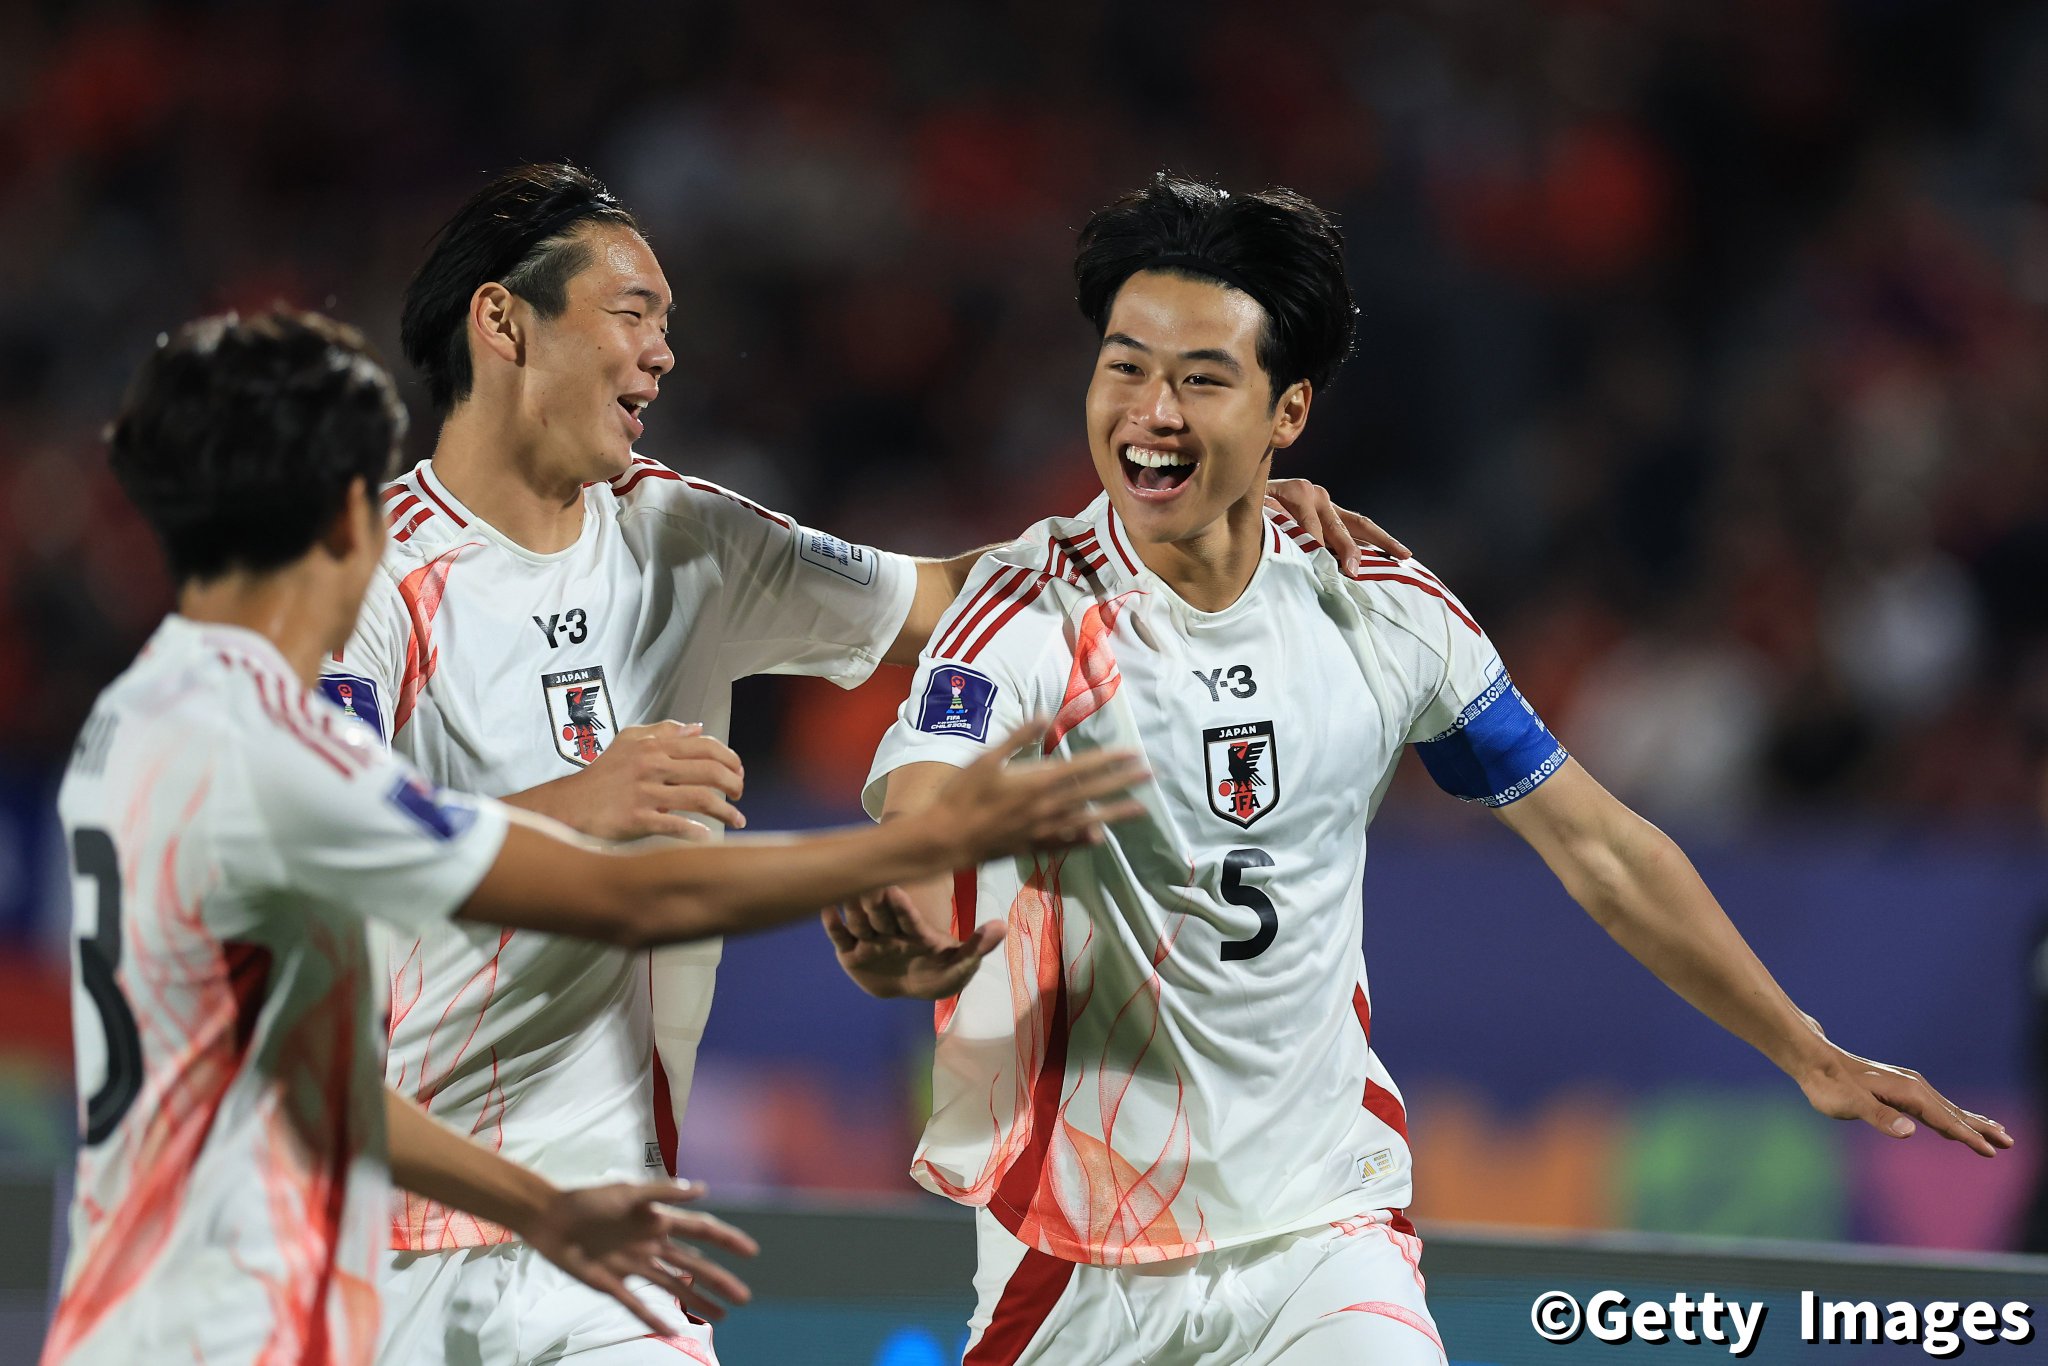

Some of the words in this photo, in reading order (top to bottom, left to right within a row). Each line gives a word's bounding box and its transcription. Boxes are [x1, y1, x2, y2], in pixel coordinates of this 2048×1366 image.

[532, 608, 588, 649] Y-3
[555, 670, 590, 683] JAPAN
[1192, 664, 1258, 702] Y-3
[1218, 724, 1258, 739] JAPAN
[573, 736, 604, 757] JFA
[1228, 793, 1261, 812] JFA
[1220, 848, 1278, 961] 5
